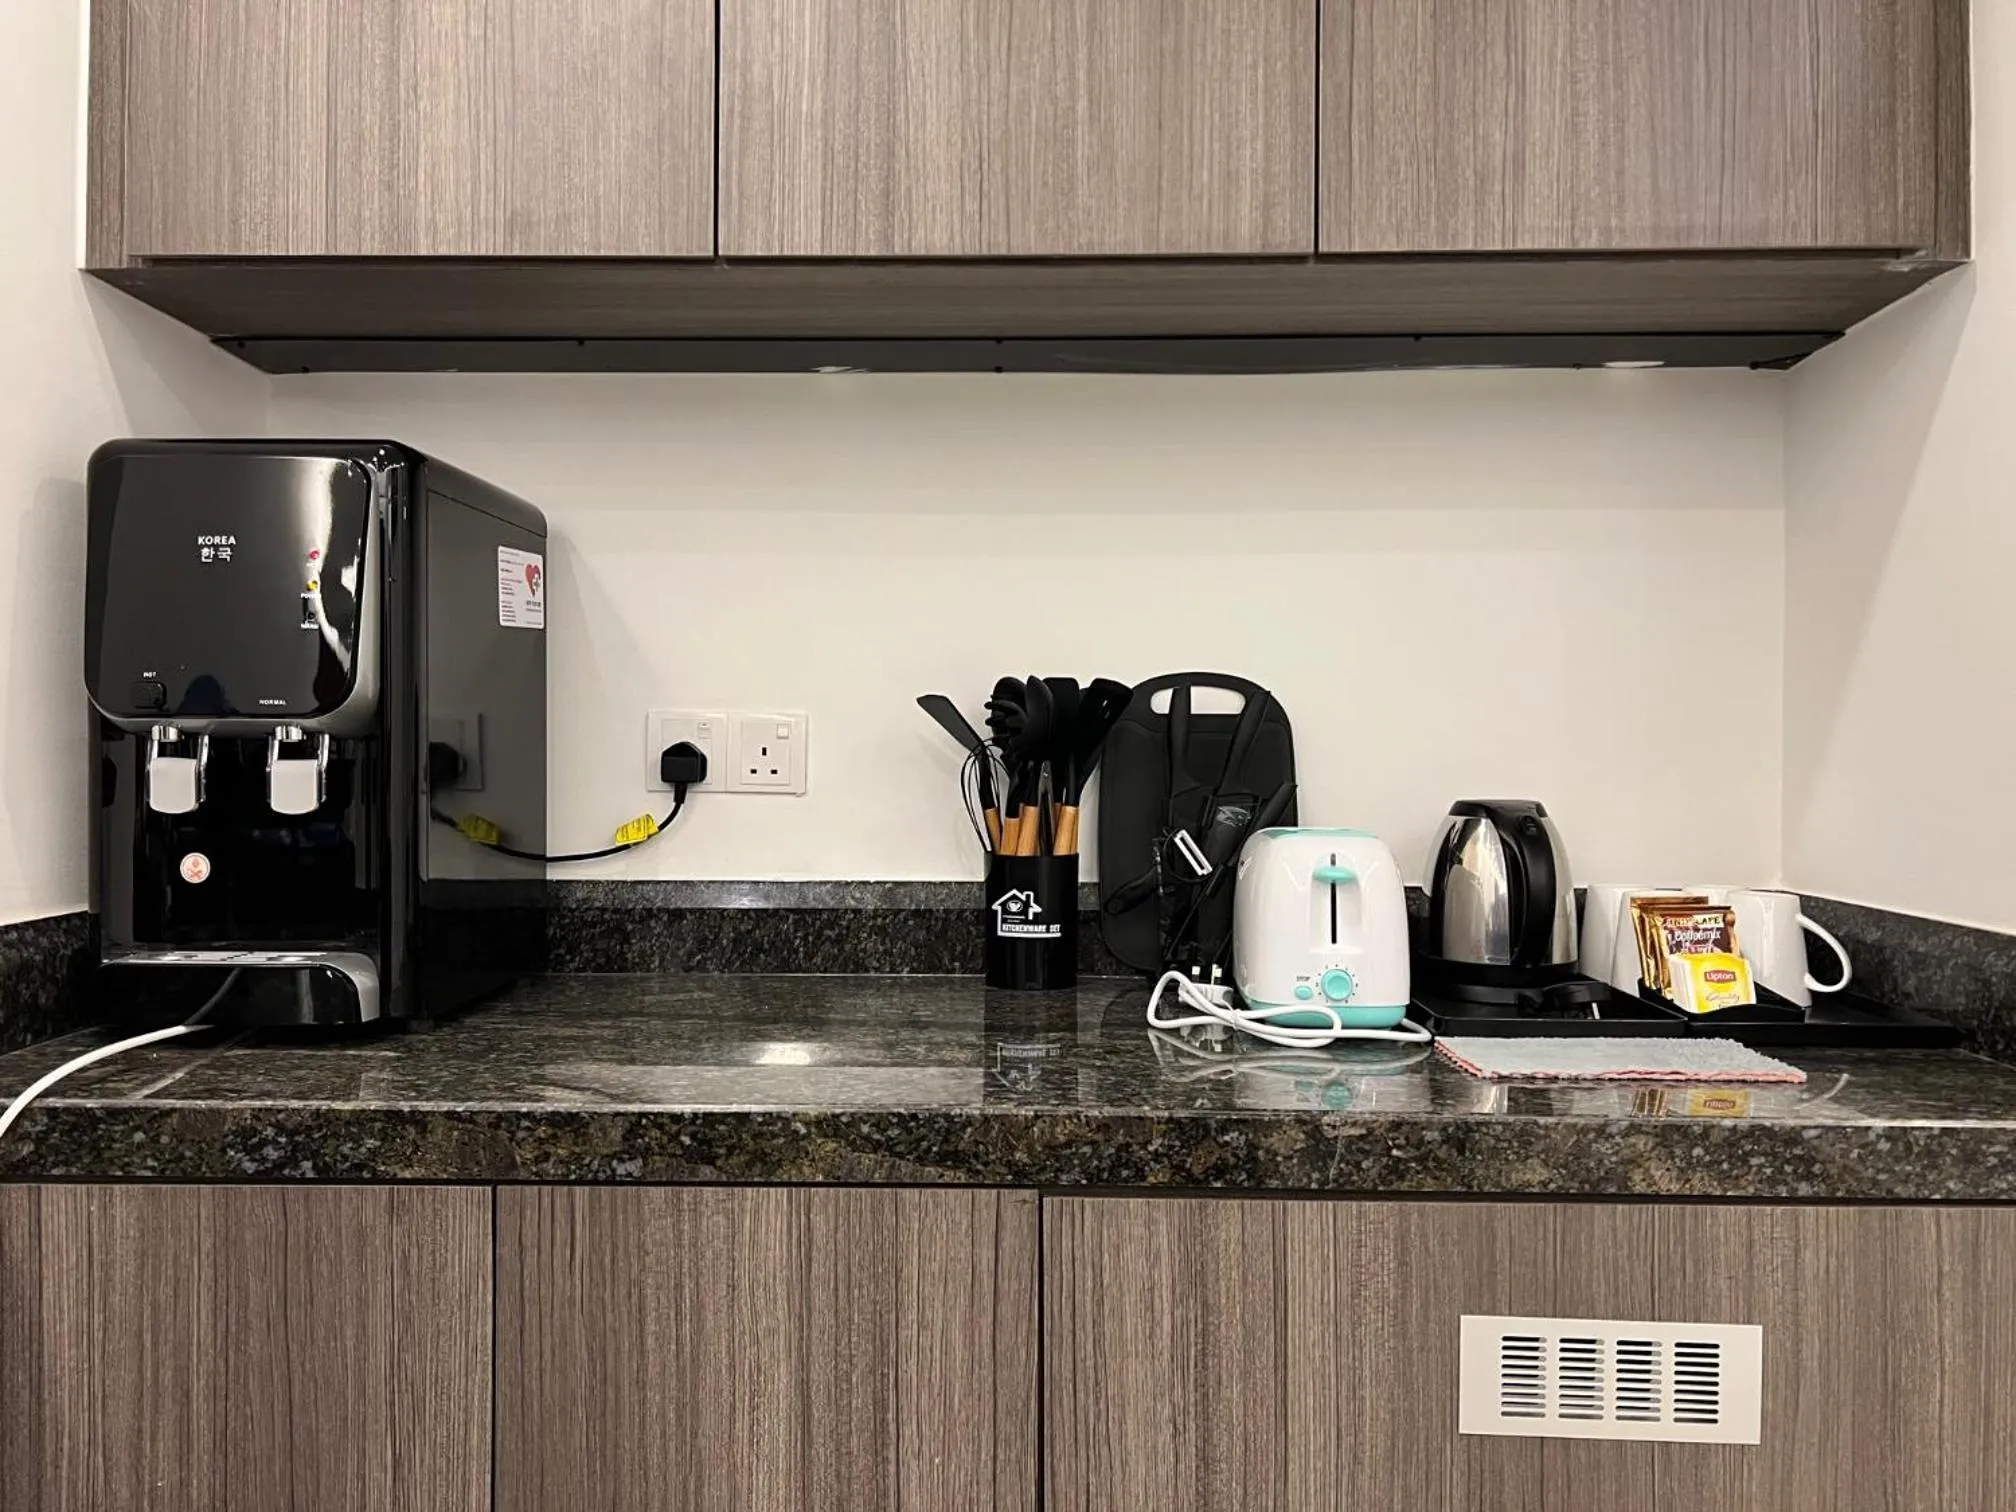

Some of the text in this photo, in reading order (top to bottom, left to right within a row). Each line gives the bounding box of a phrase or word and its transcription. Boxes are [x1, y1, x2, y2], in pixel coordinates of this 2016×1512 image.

[198, 535, 236, 545] KOREA
[201, 547, 232, 562] 한국
[1706, 971, 1734, 981] Lipton
